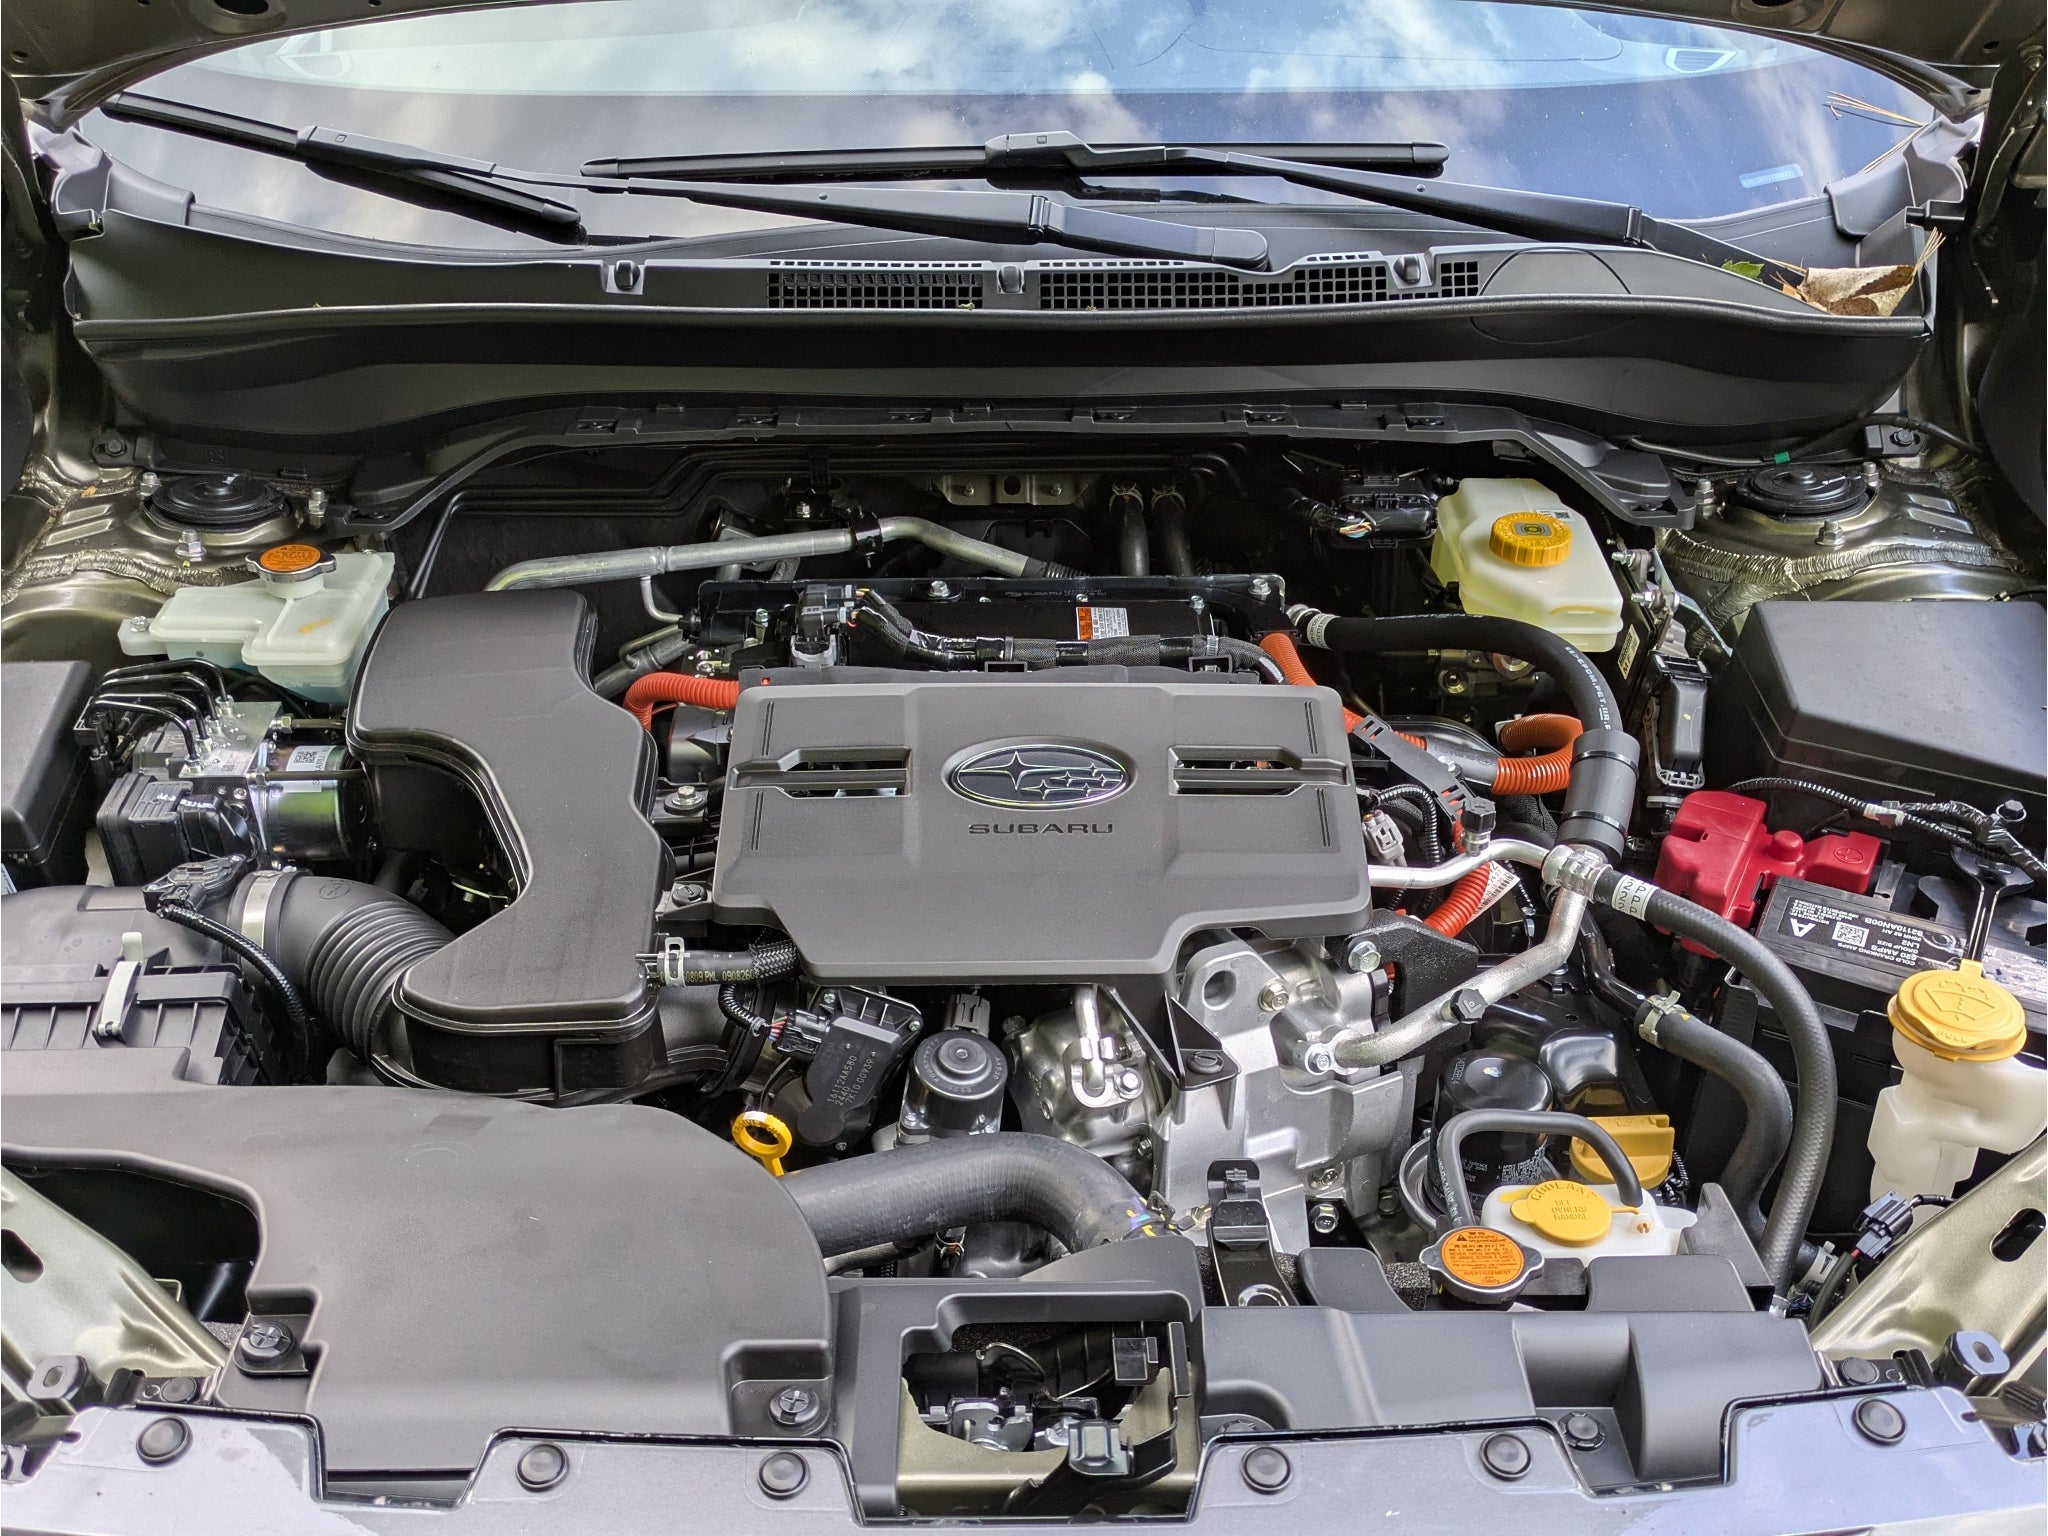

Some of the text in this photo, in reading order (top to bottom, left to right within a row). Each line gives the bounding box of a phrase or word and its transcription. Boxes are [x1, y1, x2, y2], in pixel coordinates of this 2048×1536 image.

[968, 823, 1113, 834] SUBARU
[1790, 918, 1816, 937] A
[1894, 944, 1918, 954] GROUP
[1902, 940, 1920, 949] LN2
[1859, 948, 1894, 960] CRANKING
[1871, 945, 1898, 956] AMPS
